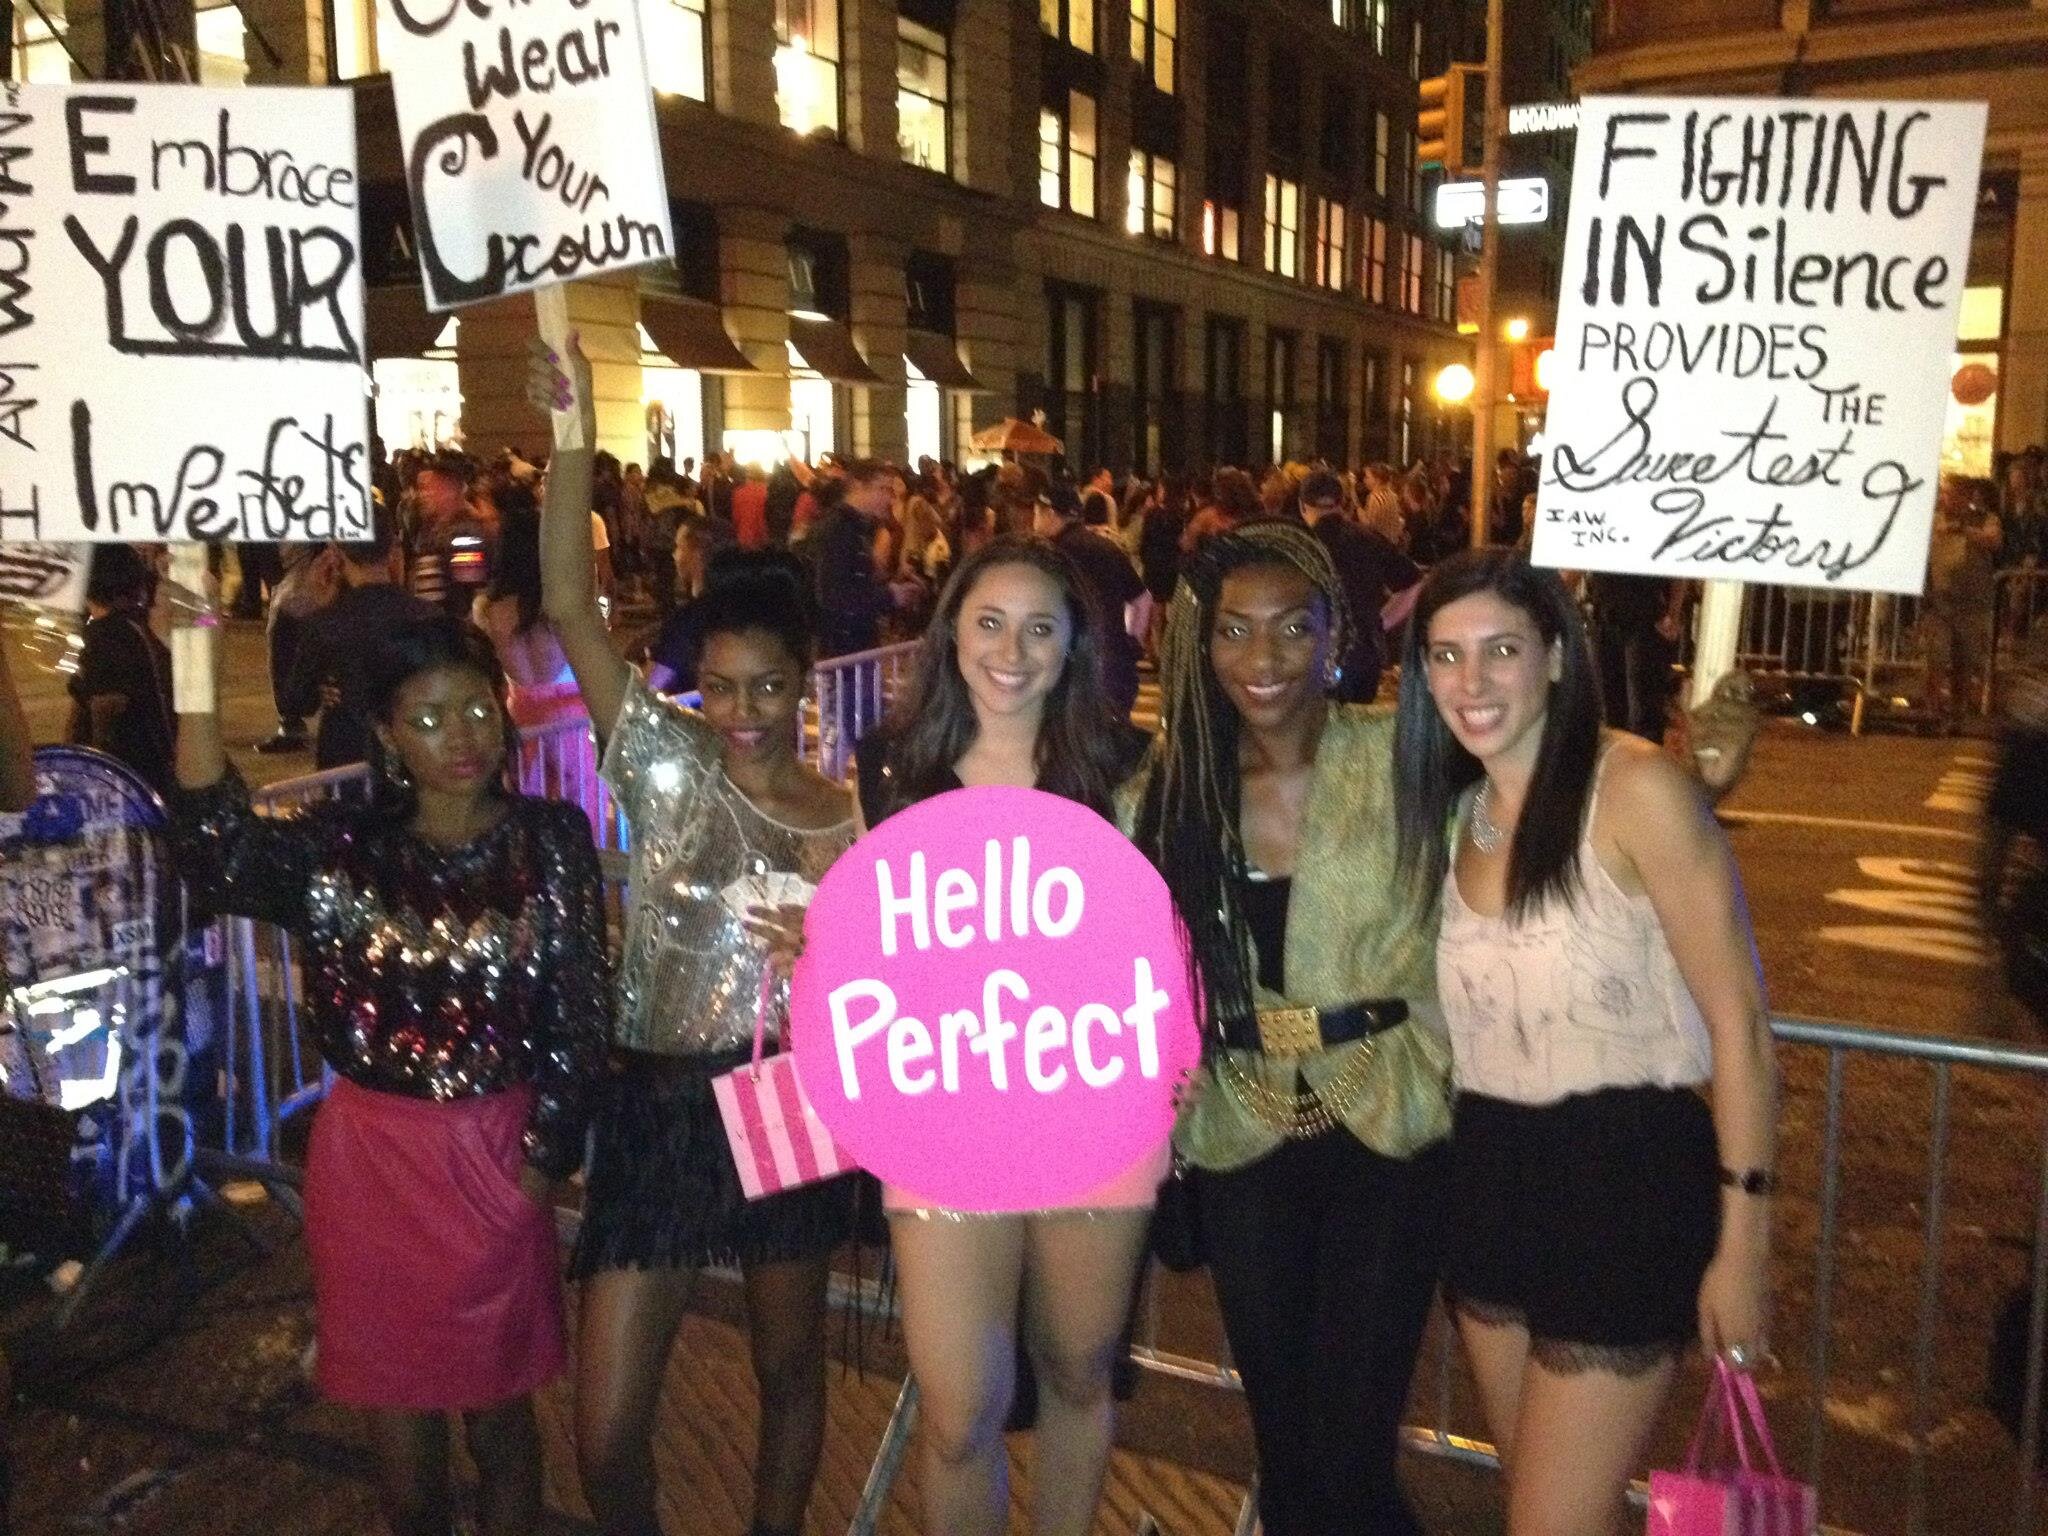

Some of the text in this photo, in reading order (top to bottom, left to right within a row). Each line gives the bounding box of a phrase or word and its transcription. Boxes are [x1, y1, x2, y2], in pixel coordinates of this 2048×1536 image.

[463, 18, 620, 111] Wear
[66, 96, 353, 209] Embrace
[513, 108, 609, 214] Your
[1599, 109, 1947, 219] FIGHTING
[63, 212, 366, 366] YOUR
[1582, 212, 1949, 312] IN Silence
[1578, 321, 1828, 380] PROVIDES
[1808, 382, 1887, 425] THE
[1543, 376, 1855, 492] Sweetest
[875, 835, 1085, 957] Hello
[827, 956, 1170, 1101] Perfect
